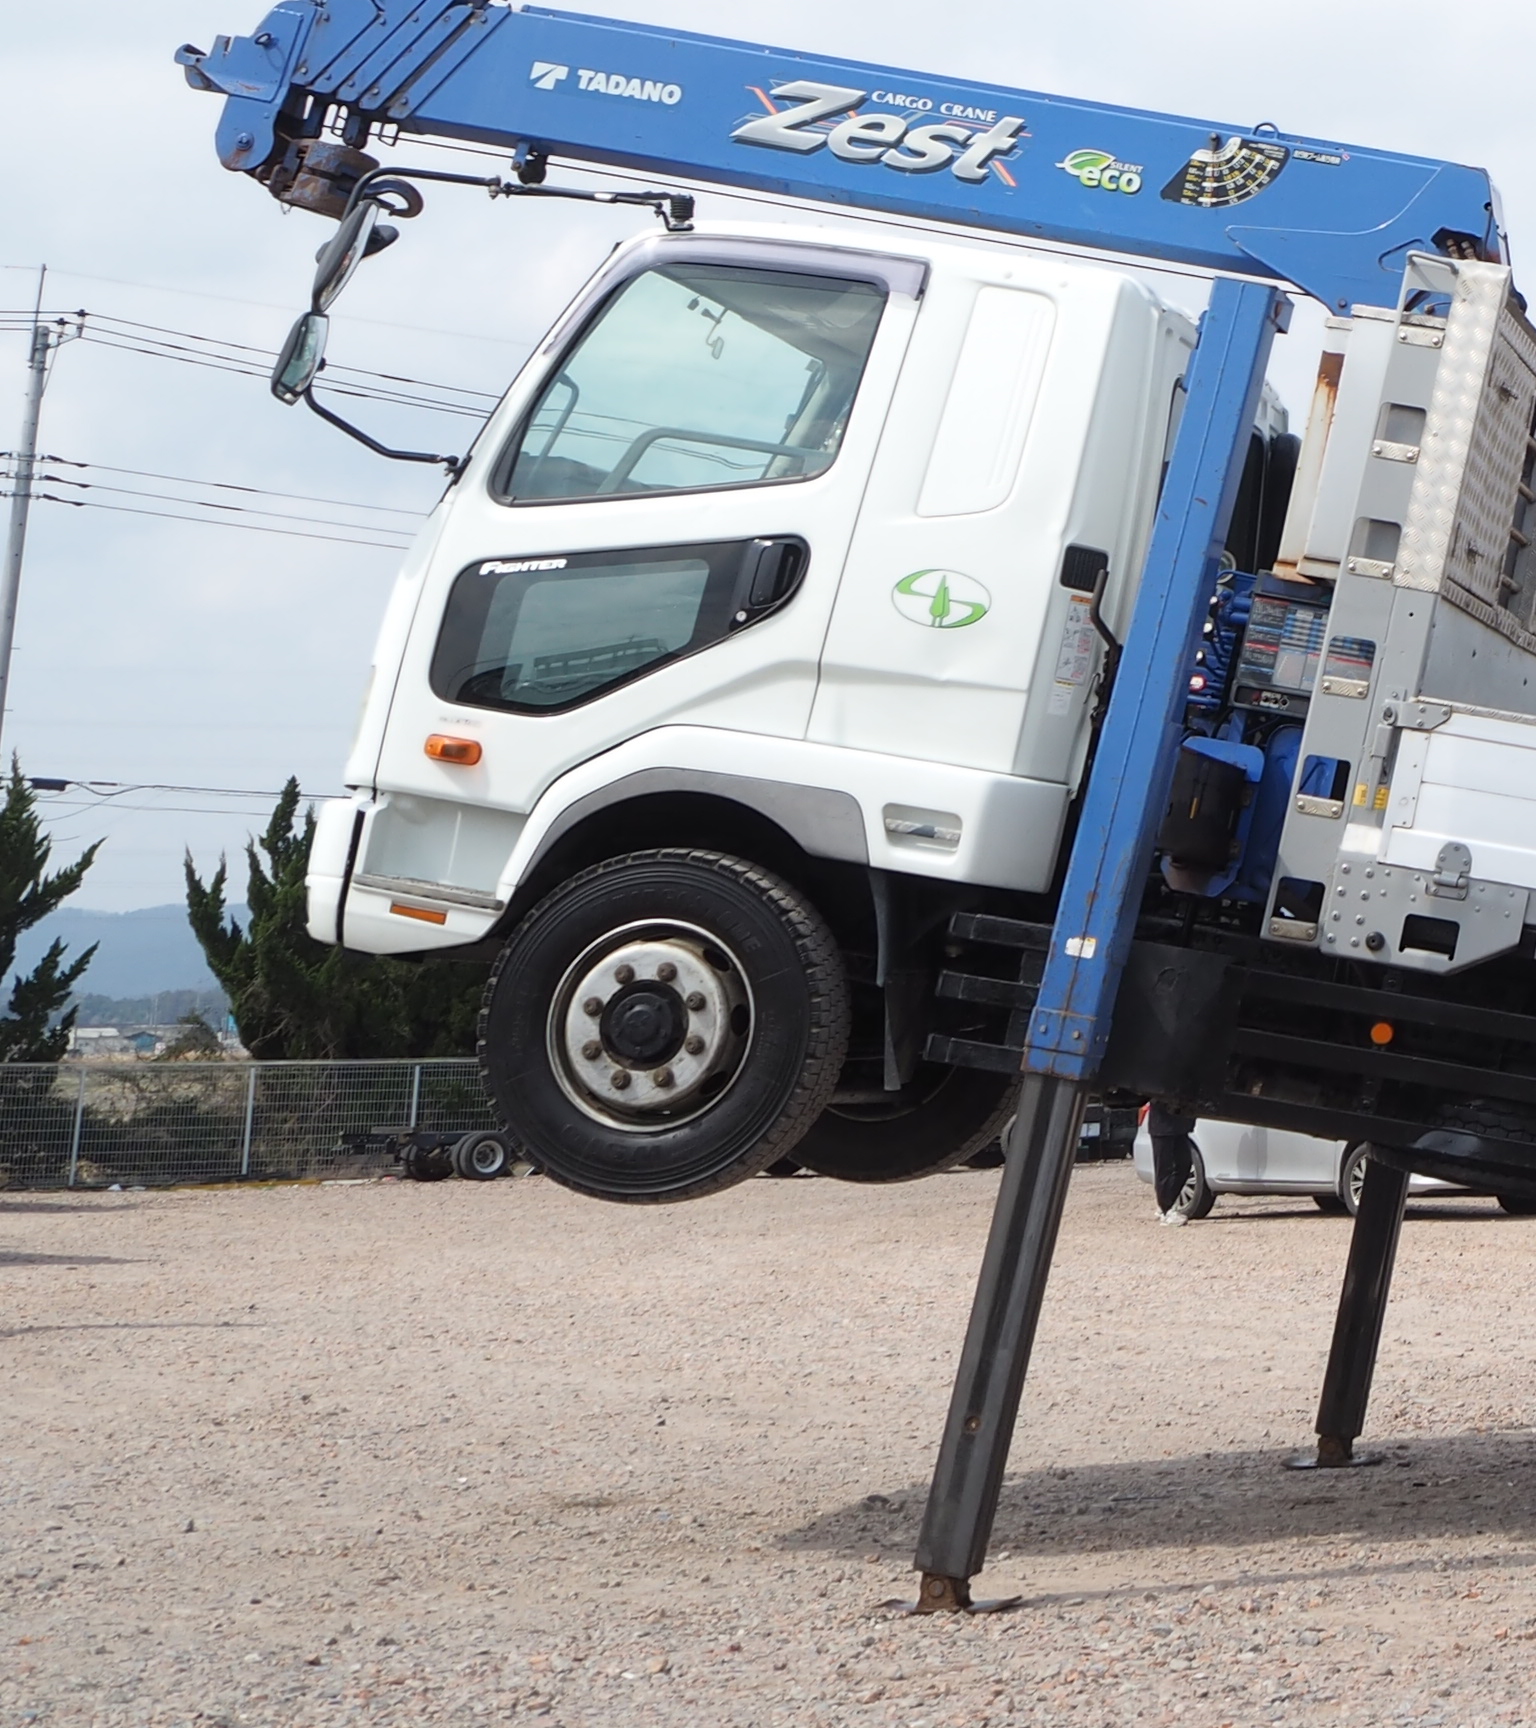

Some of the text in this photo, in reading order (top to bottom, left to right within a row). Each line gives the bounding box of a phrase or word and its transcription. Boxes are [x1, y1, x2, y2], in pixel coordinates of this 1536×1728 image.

[577, 68, 682, 105] TADANO
[871, 90, 998, 123] CARGO CRANE
[729, 80, 1025, 180] Zest
[1080, 166, 1142, 193] eco
[1109, 161, 1144, 174] SILENT
